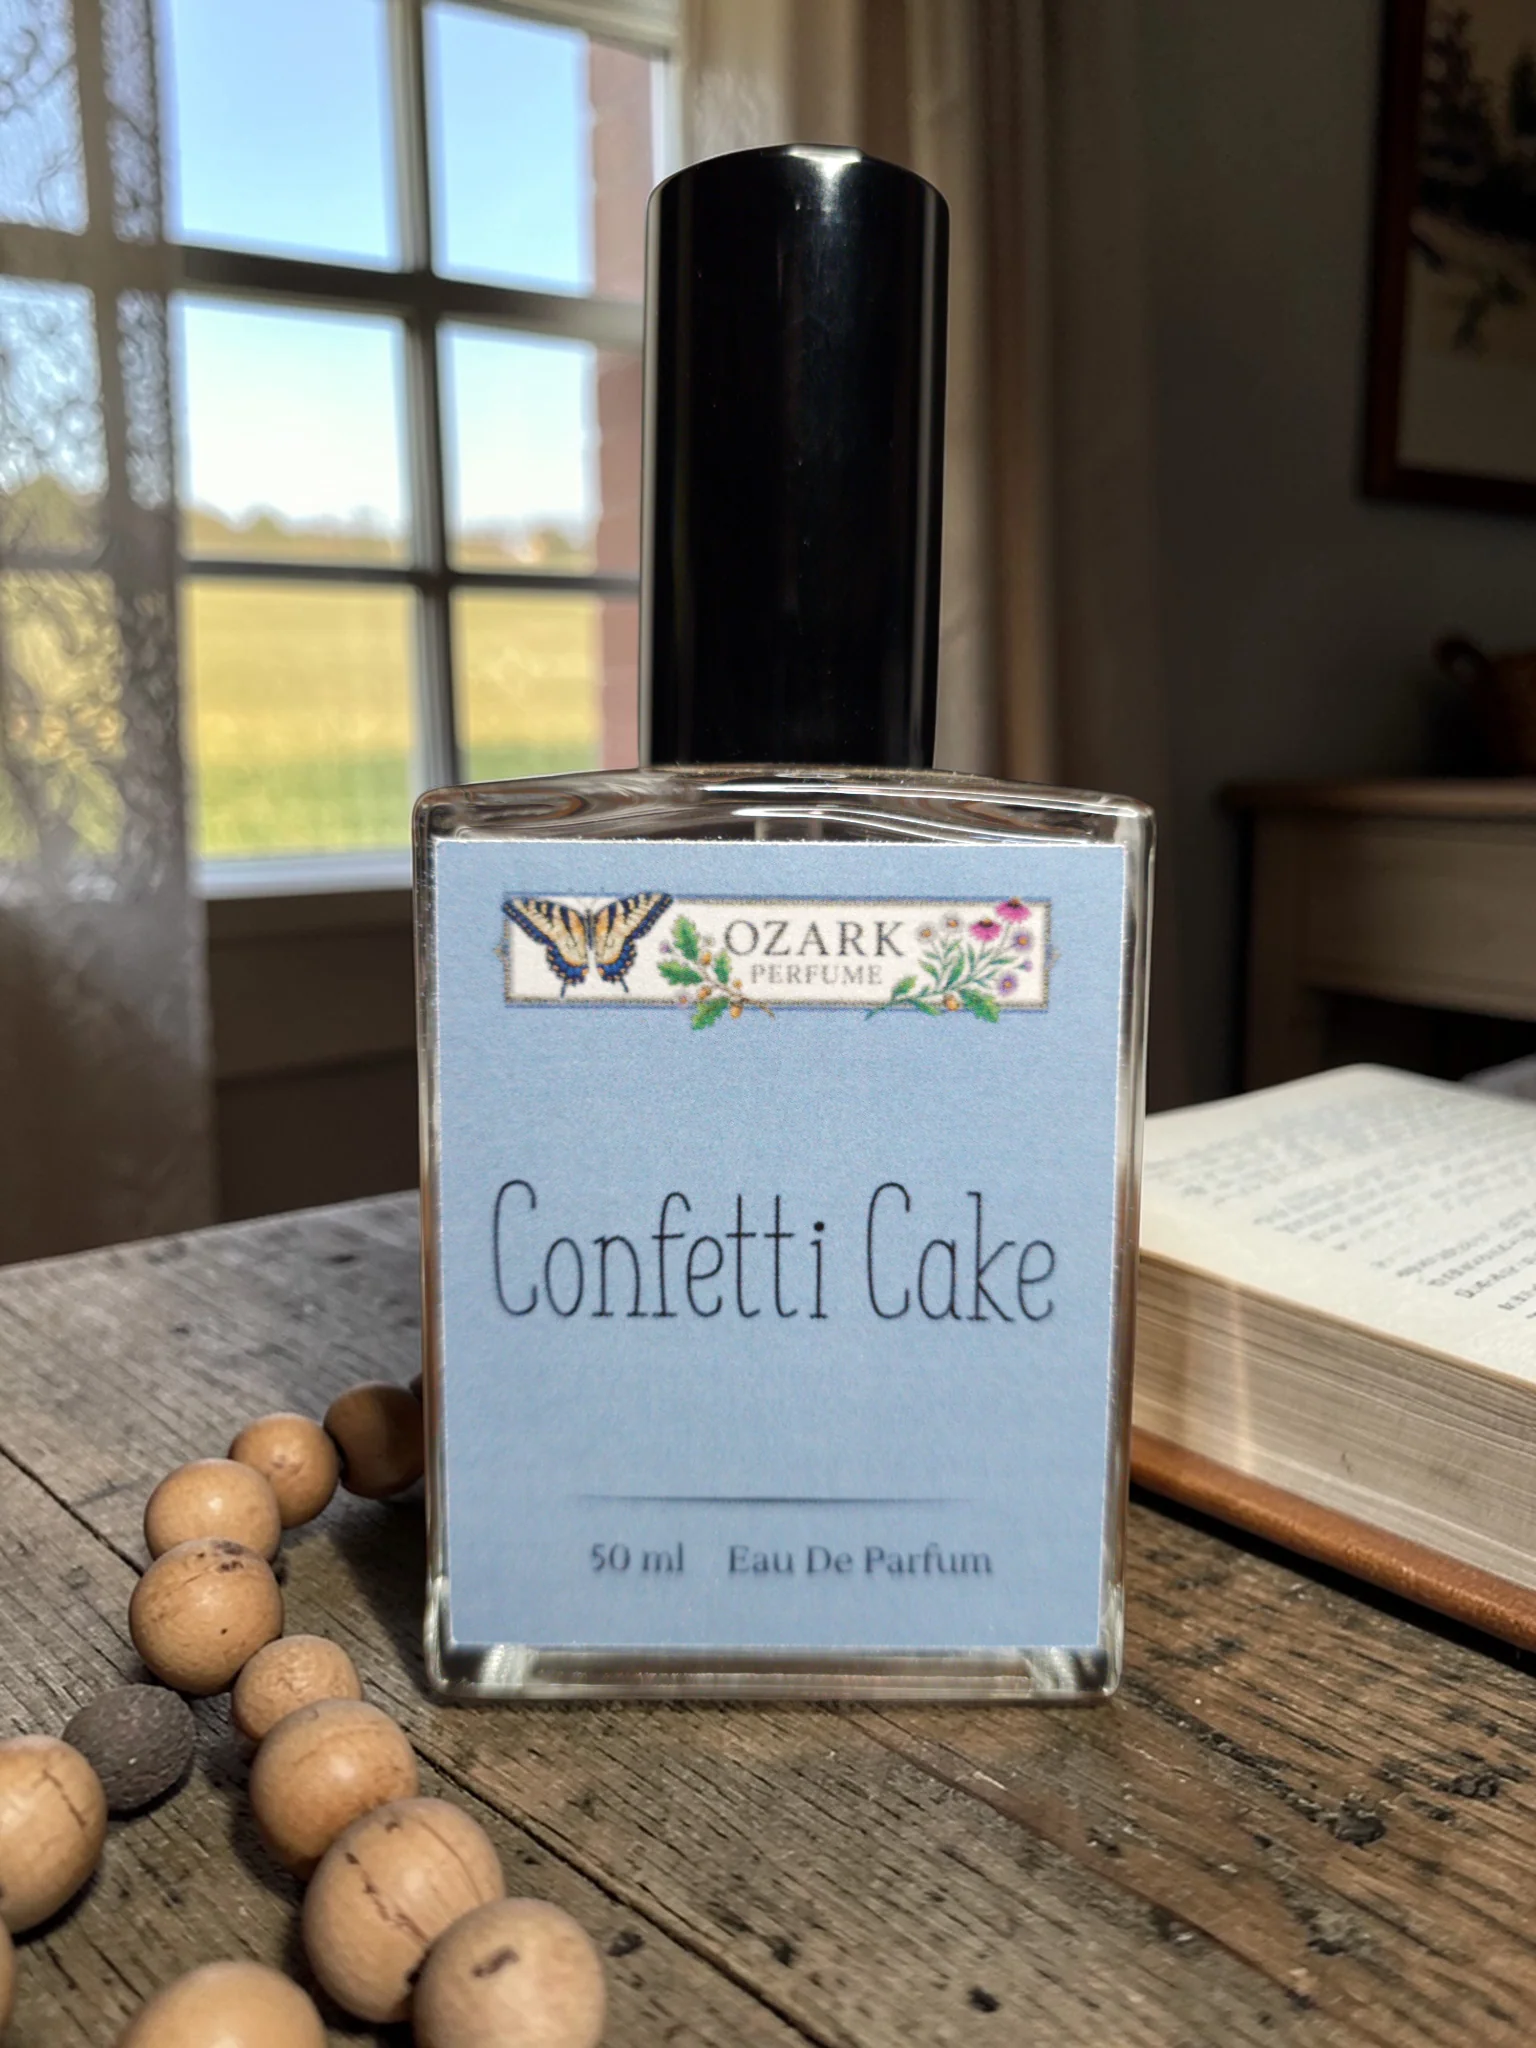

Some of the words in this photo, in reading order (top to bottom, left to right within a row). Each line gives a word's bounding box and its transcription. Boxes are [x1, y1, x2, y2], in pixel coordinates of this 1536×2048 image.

[723, 919, 908, 958] OZARK
[750, 963, 884, 987] PERFUME
[493, 1179, 829, 1320] Confetti
[867, 1182, 1057, 1324] Cake
[589, 1543, 632, 1574] 50
[641, 1542, 684, 1574] ml
[727, 1545, 795, 1575] Eau
[805, 1545, 853, 1575] De
[864, 1543, 994, 1576] Parfum
